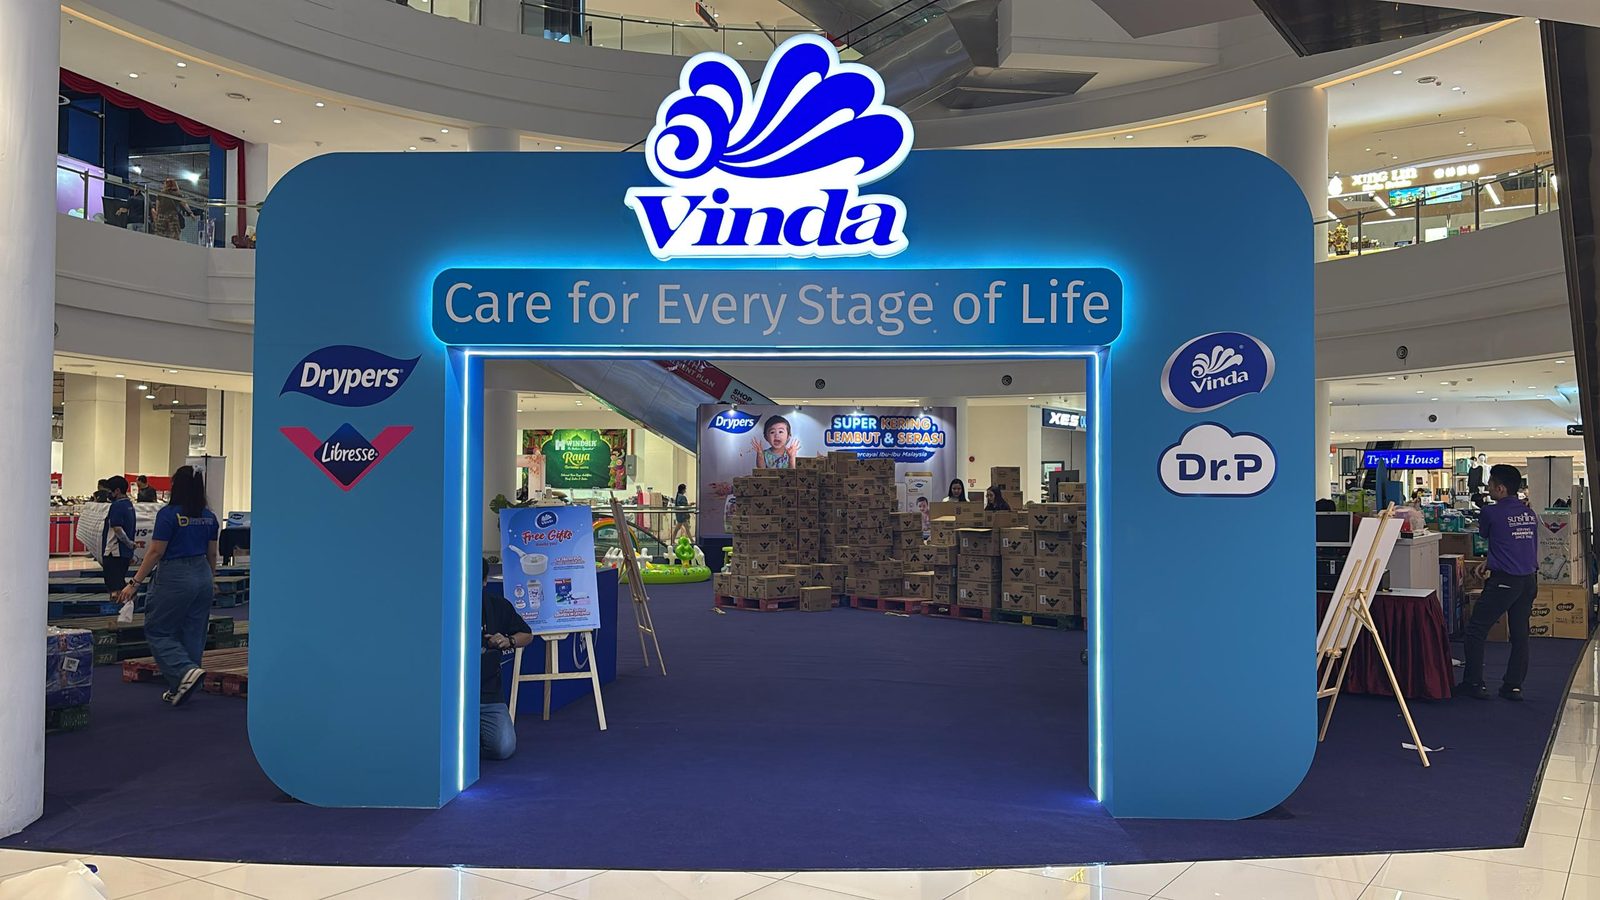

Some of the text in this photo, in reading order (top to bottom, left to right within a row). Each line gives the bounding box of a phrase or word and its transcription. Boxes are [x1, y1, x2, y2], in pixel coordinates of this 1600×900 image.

[634, 187, 899, 249] Vinda
[445, 278, 1109, 336] Care for Every Stage of Life
[300, 362, 400, 395] Drypers
[696, 373, 716, 388] PLAN
[1190, 370, 1249, 394] Vinda
[733, 388, 753, 402] SHOP
[716, 415, 754, 428] Drypers
[834, 417, 936, 432] SUPER KERING,
[1049, 411, 1079, 426] XES
[826, 432, 944, 445] LEMBUT & SERASI
[321, 442, 375, 463] Libresse
[562, 451, 590, 466] Raya
[1367, 454, 1440, 464] Trvel House
[1176, 454, 1263, 481] Dr.P
[1508, 513, 1536, 523] sunshine
[522, 528, 573, 545] Free Gifts
